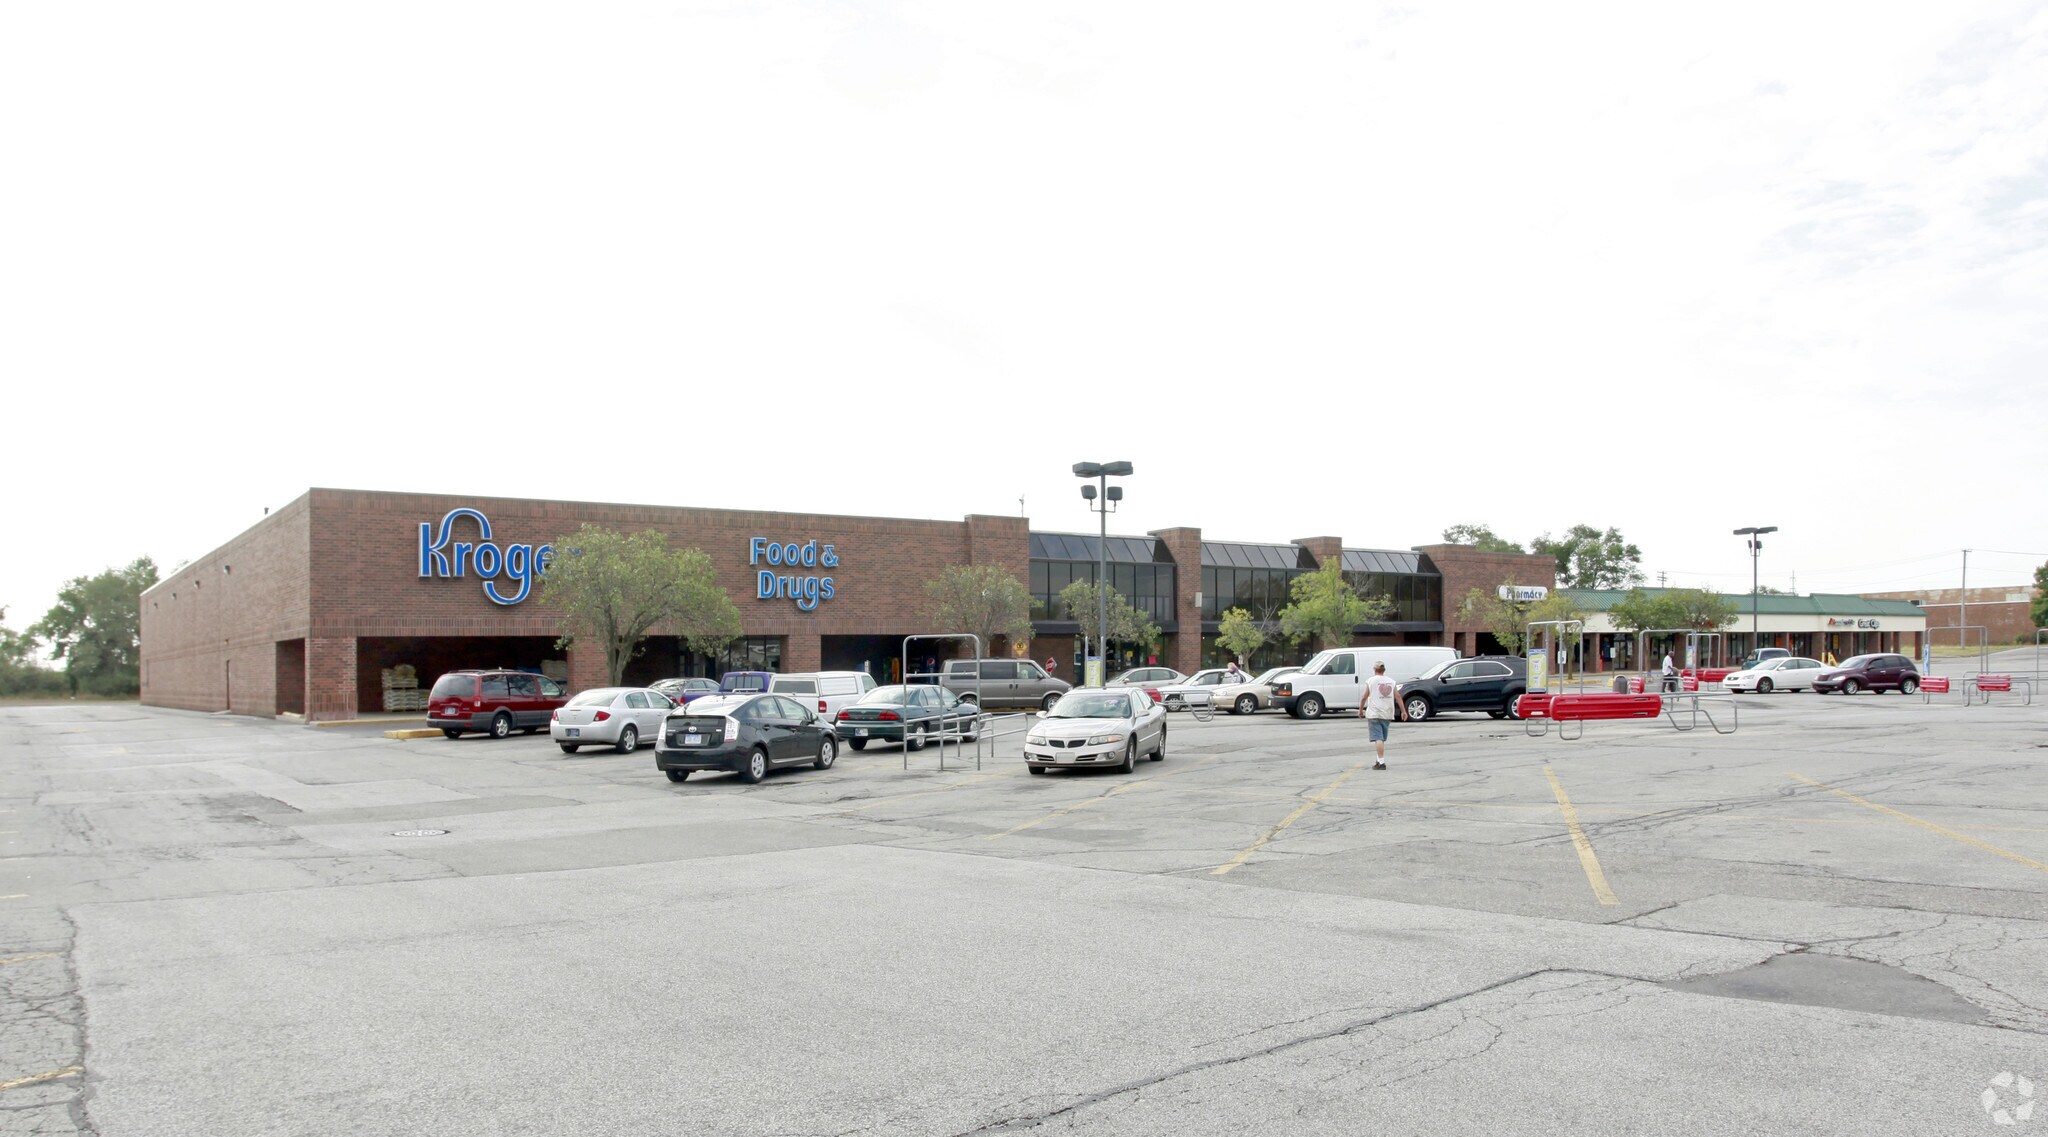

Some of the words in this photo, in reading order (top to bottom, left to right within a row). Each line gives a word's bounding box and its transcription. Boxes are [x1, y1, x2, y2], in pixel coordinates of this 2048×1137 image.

[418, 507, 582, 605] Kroge
[749, 537, 816, 567] Food
[820, 544, 839, 567] &
[757, 570, 835, 611] Drugs
